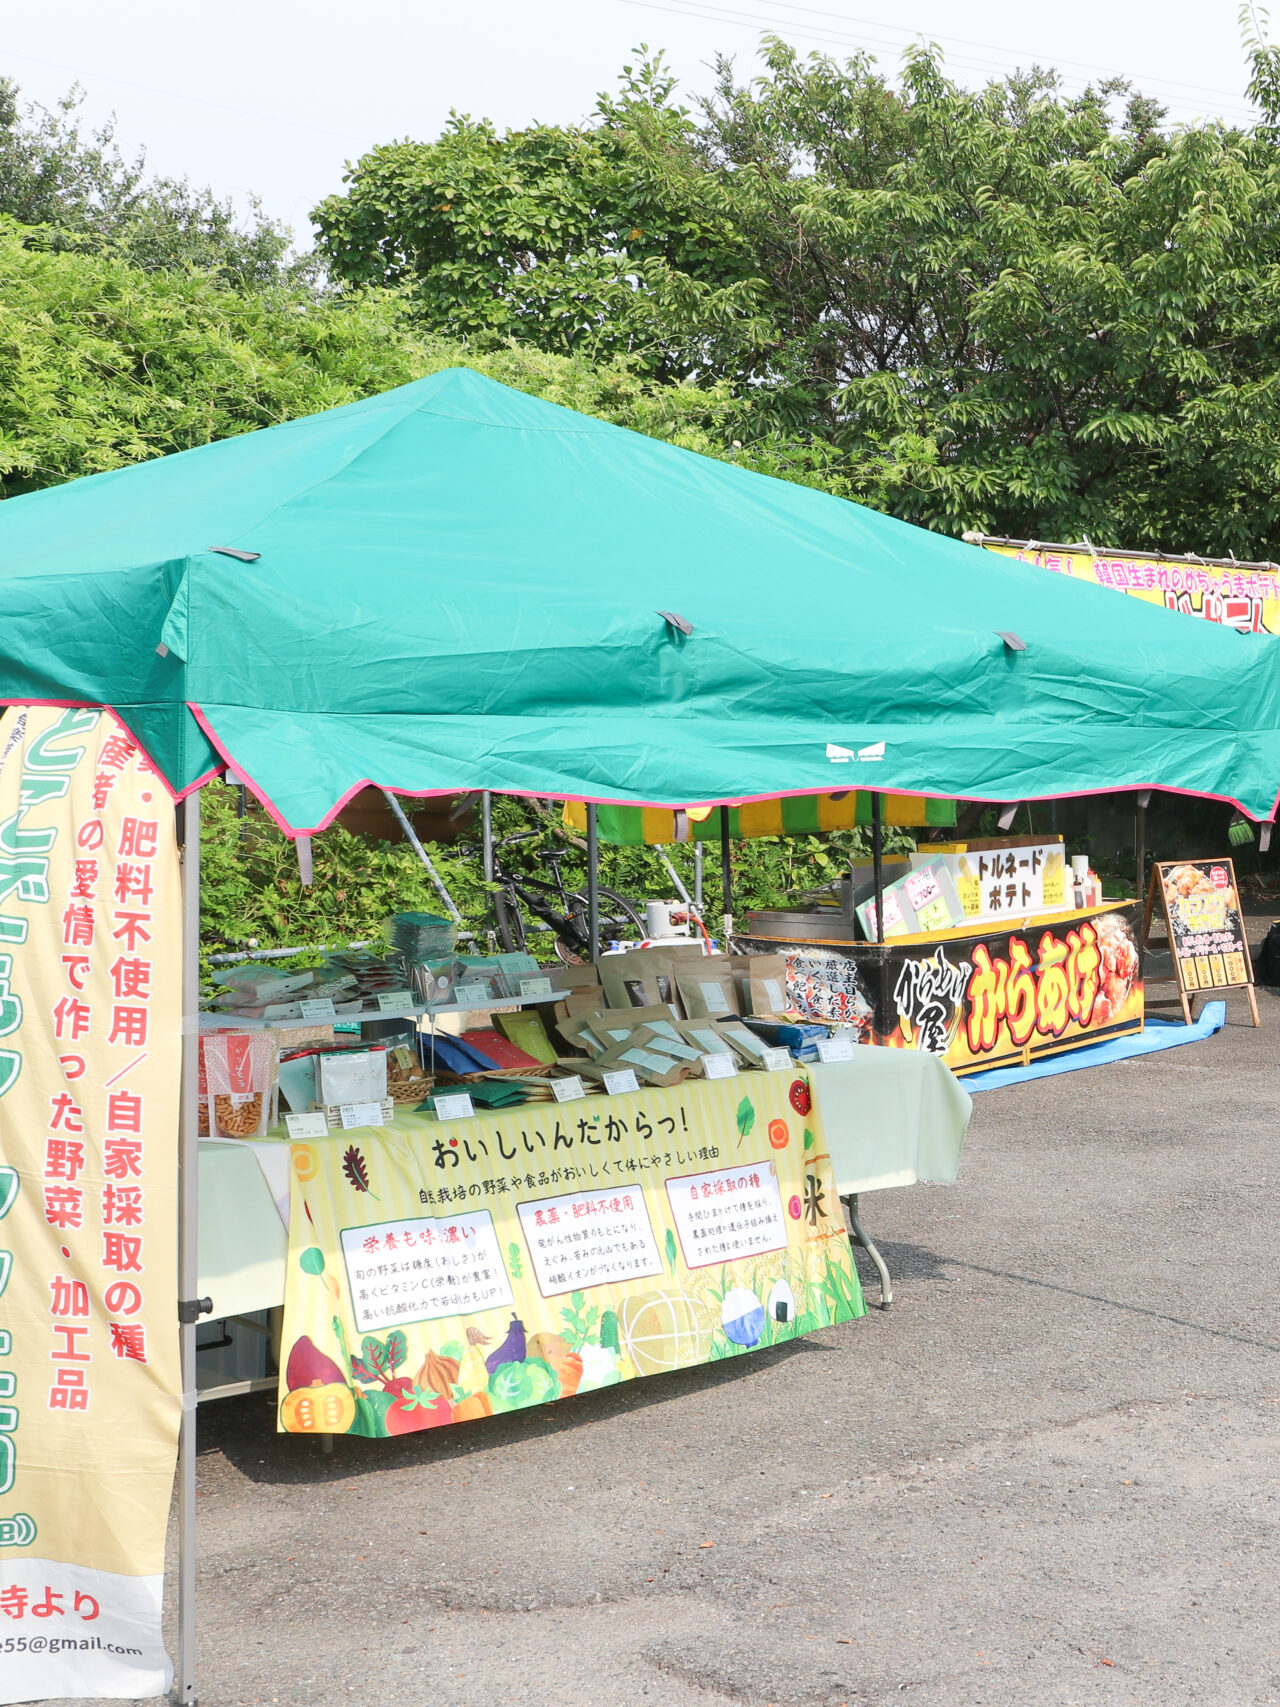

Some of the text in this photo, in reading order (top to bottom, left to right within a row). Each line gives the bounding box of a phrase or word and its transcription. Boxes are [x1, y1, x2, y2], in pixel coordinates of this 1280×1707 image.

[979, 849, 1043, 881] トルネード
[989, 882, 1031, 911] ポテト
[967, 922, 1101, 1054] からあげ
[44, 722, 136, 1412] 産者の愛情で作った野菜・加工品
[431, 1106, 689, 1170] おいしいんだからっ!
[690, 1172, 760, 1200] 自家採取の種
[804, 1174, 828, 1226] 米
[534, 1195, 634, 1227] 農薬・肥料不使用
